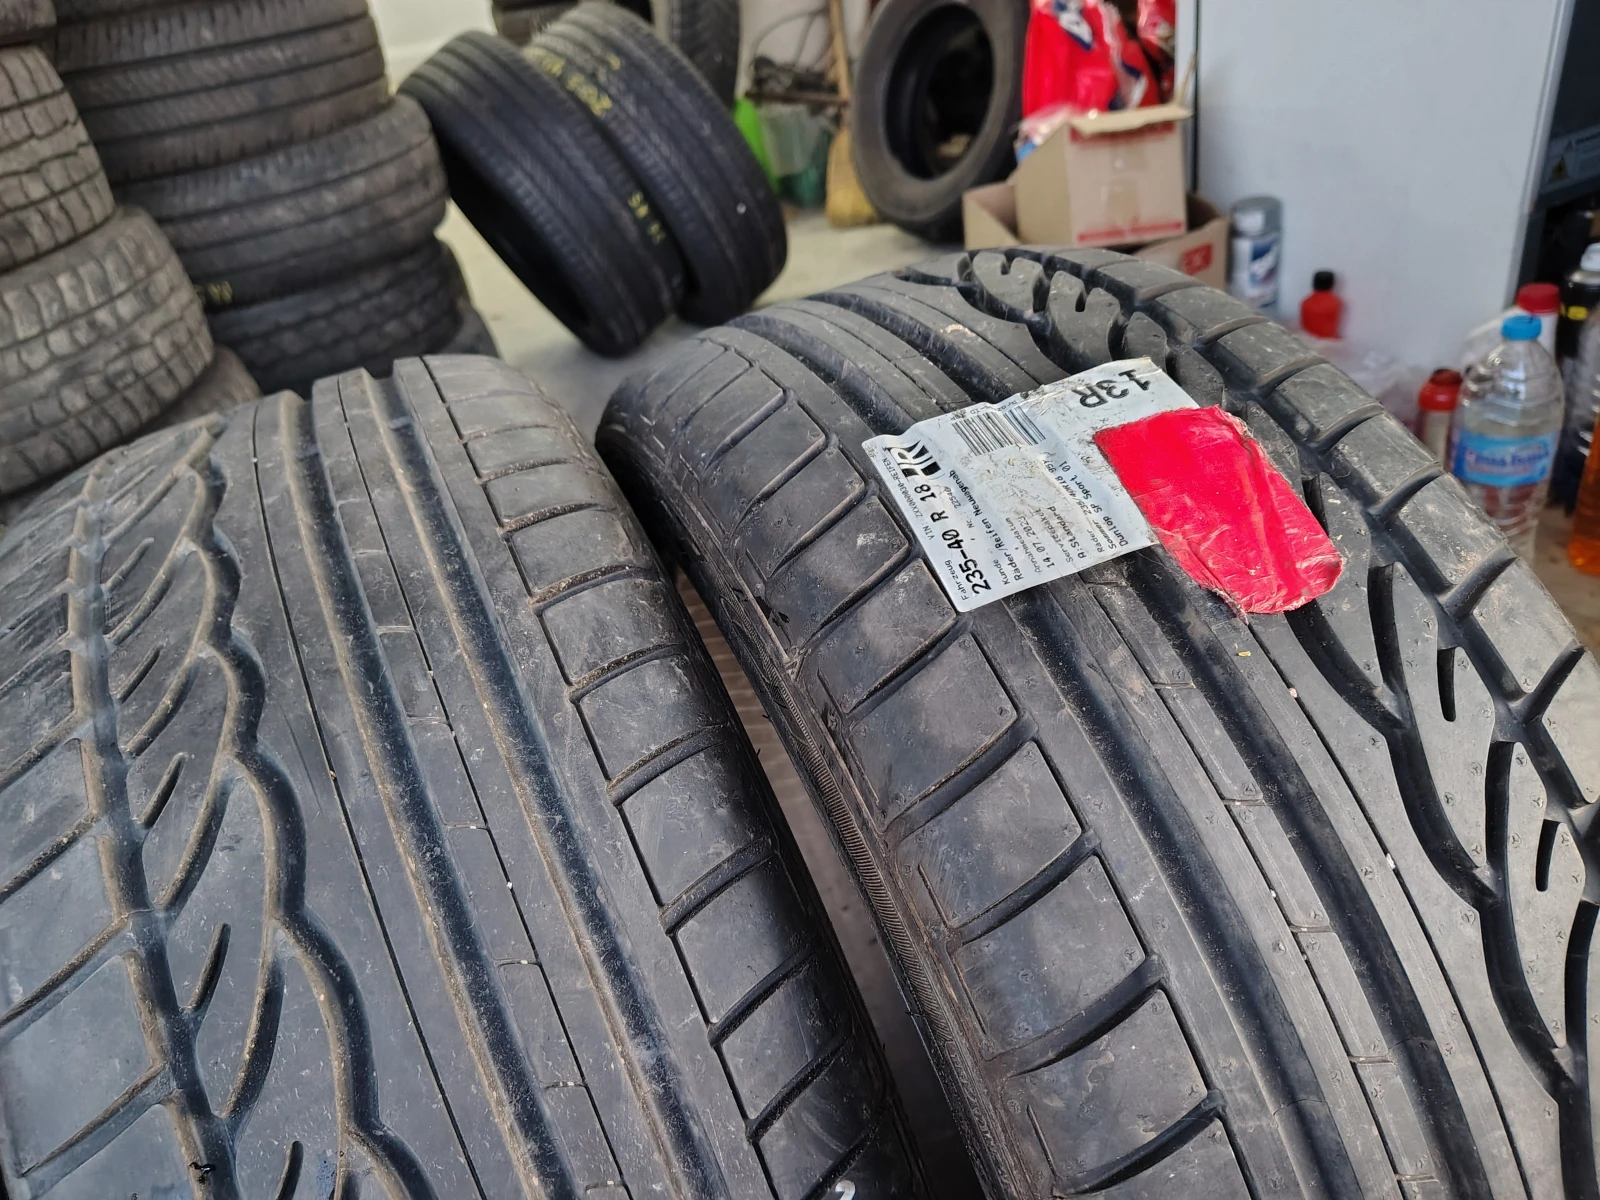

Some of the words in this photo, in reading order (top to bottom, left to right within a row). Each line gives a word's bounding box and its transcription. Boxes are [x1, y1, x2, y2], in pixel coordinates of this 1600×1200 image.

[1071, 369, 1151, 408] 13R
[1056, 460, 1072, 472] 01
[912, 482, 937, 502] 18
[945, 468, 985, 516] Neuwagenab
[1053, 474, 1093, 516] 235/40R18
[1066, 473, 1095, 500] Sport
[928, 509, 949, 522] R
[1088, 501, 1104, 514] SP
[978, 517, 1025, 581] Räder/Reifen
[1003, 516, 1043, 573] Annahmedatum
[1015, 514, 1055, 568] 14.07.2023
[1032, 507, 1074, 563] Servicepaket
[1046, 505, 1087, 559] A:Standard
[1090, 518, 1117, 550] Sommer
[1100, 514, 1129, 546] Dunlop
[938, 527, 992, 595] 235-40
[942, 559, 970, 600] Fahrzeug
[990, 558, 1011, 585] Kunde
